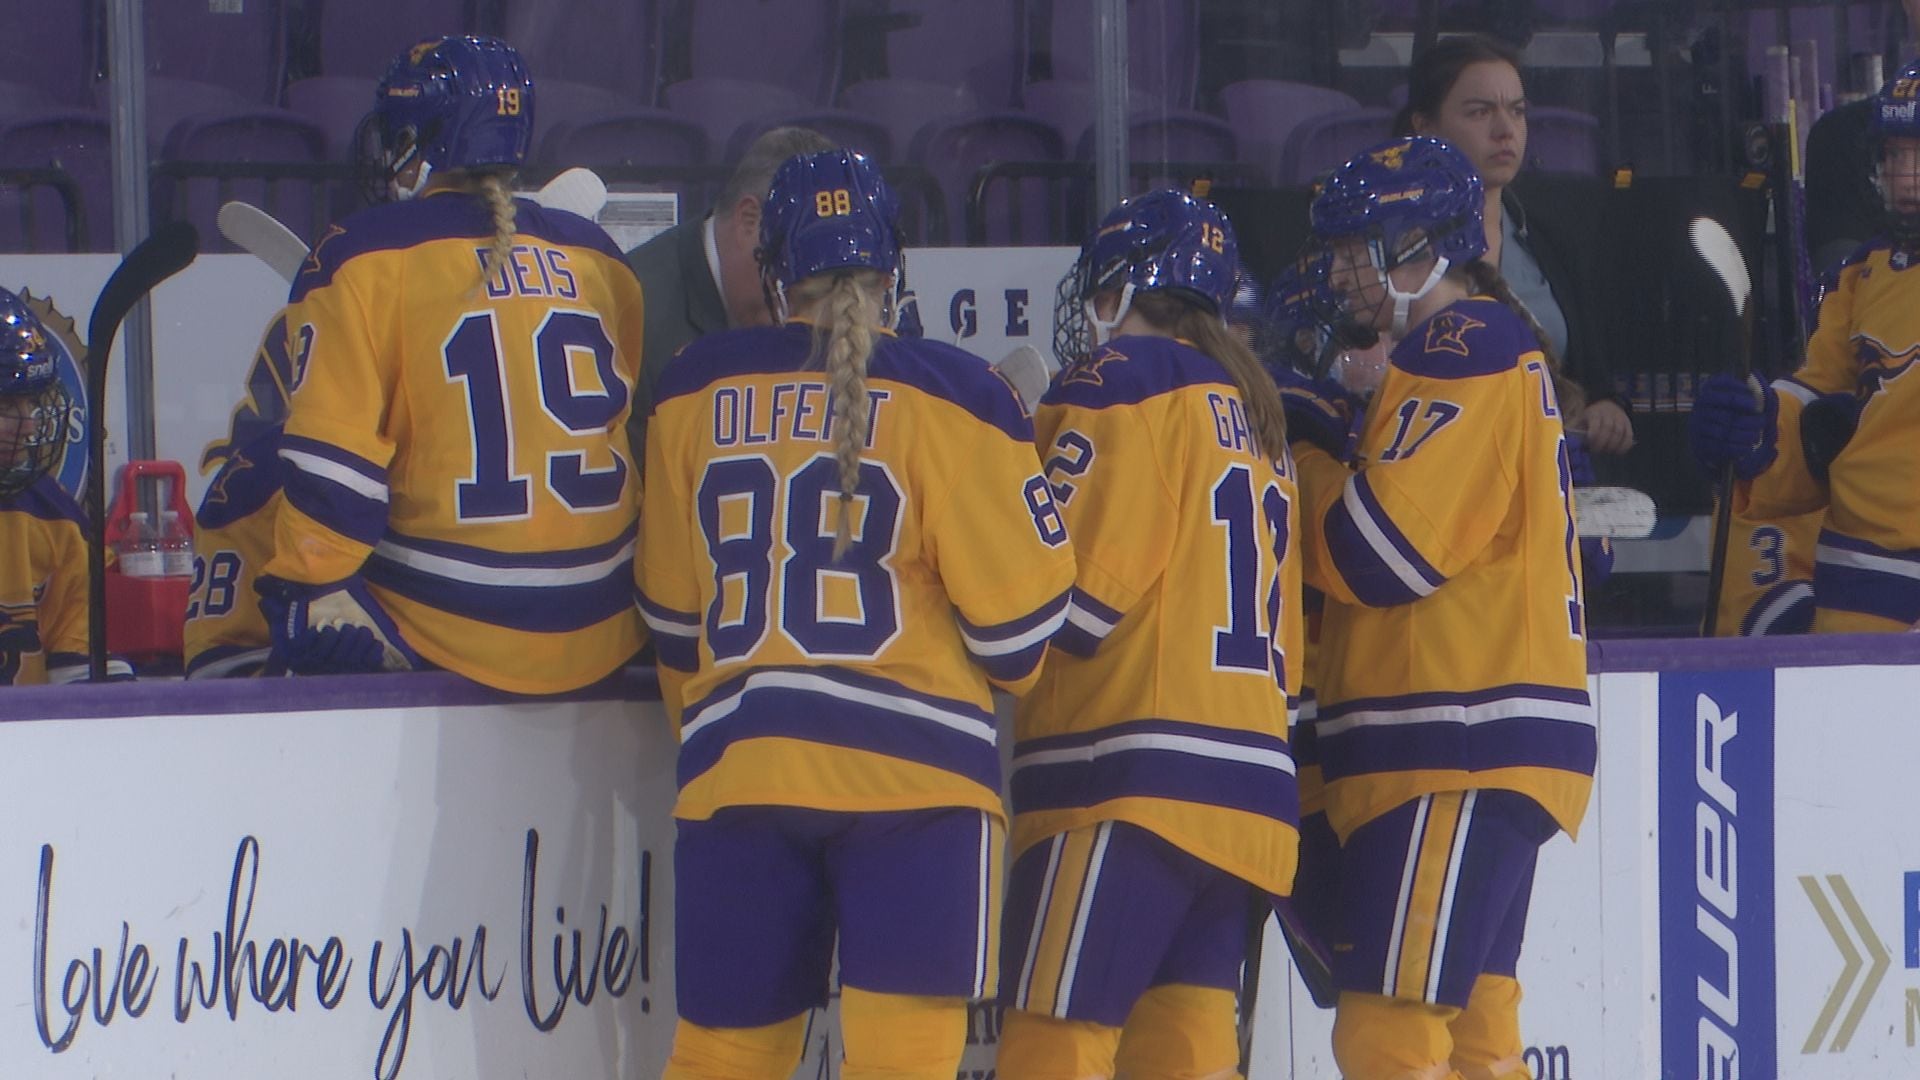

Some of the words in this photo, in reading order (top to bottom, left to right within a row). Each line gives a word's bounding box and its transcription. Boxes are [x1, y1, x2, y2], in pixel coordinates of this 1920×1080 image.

[497, 87, 520, 116] 19
[815, 189, 851, 217] 88
[1201, 222, 1225, 255] 12
[474, 245, 579, 300] DEIS
[440, 308, 633, 524] 19
[1379, 397, 1464, 463] 17
[1021, 473, 1069, 549] 8
[184, 550, 244, 620] 28
[697, 452, 907, 667] 88
[1750, 524, 1790, 587] 3
[174, 835, 353, 1023] where
[369, 922, 507, 1080] you
